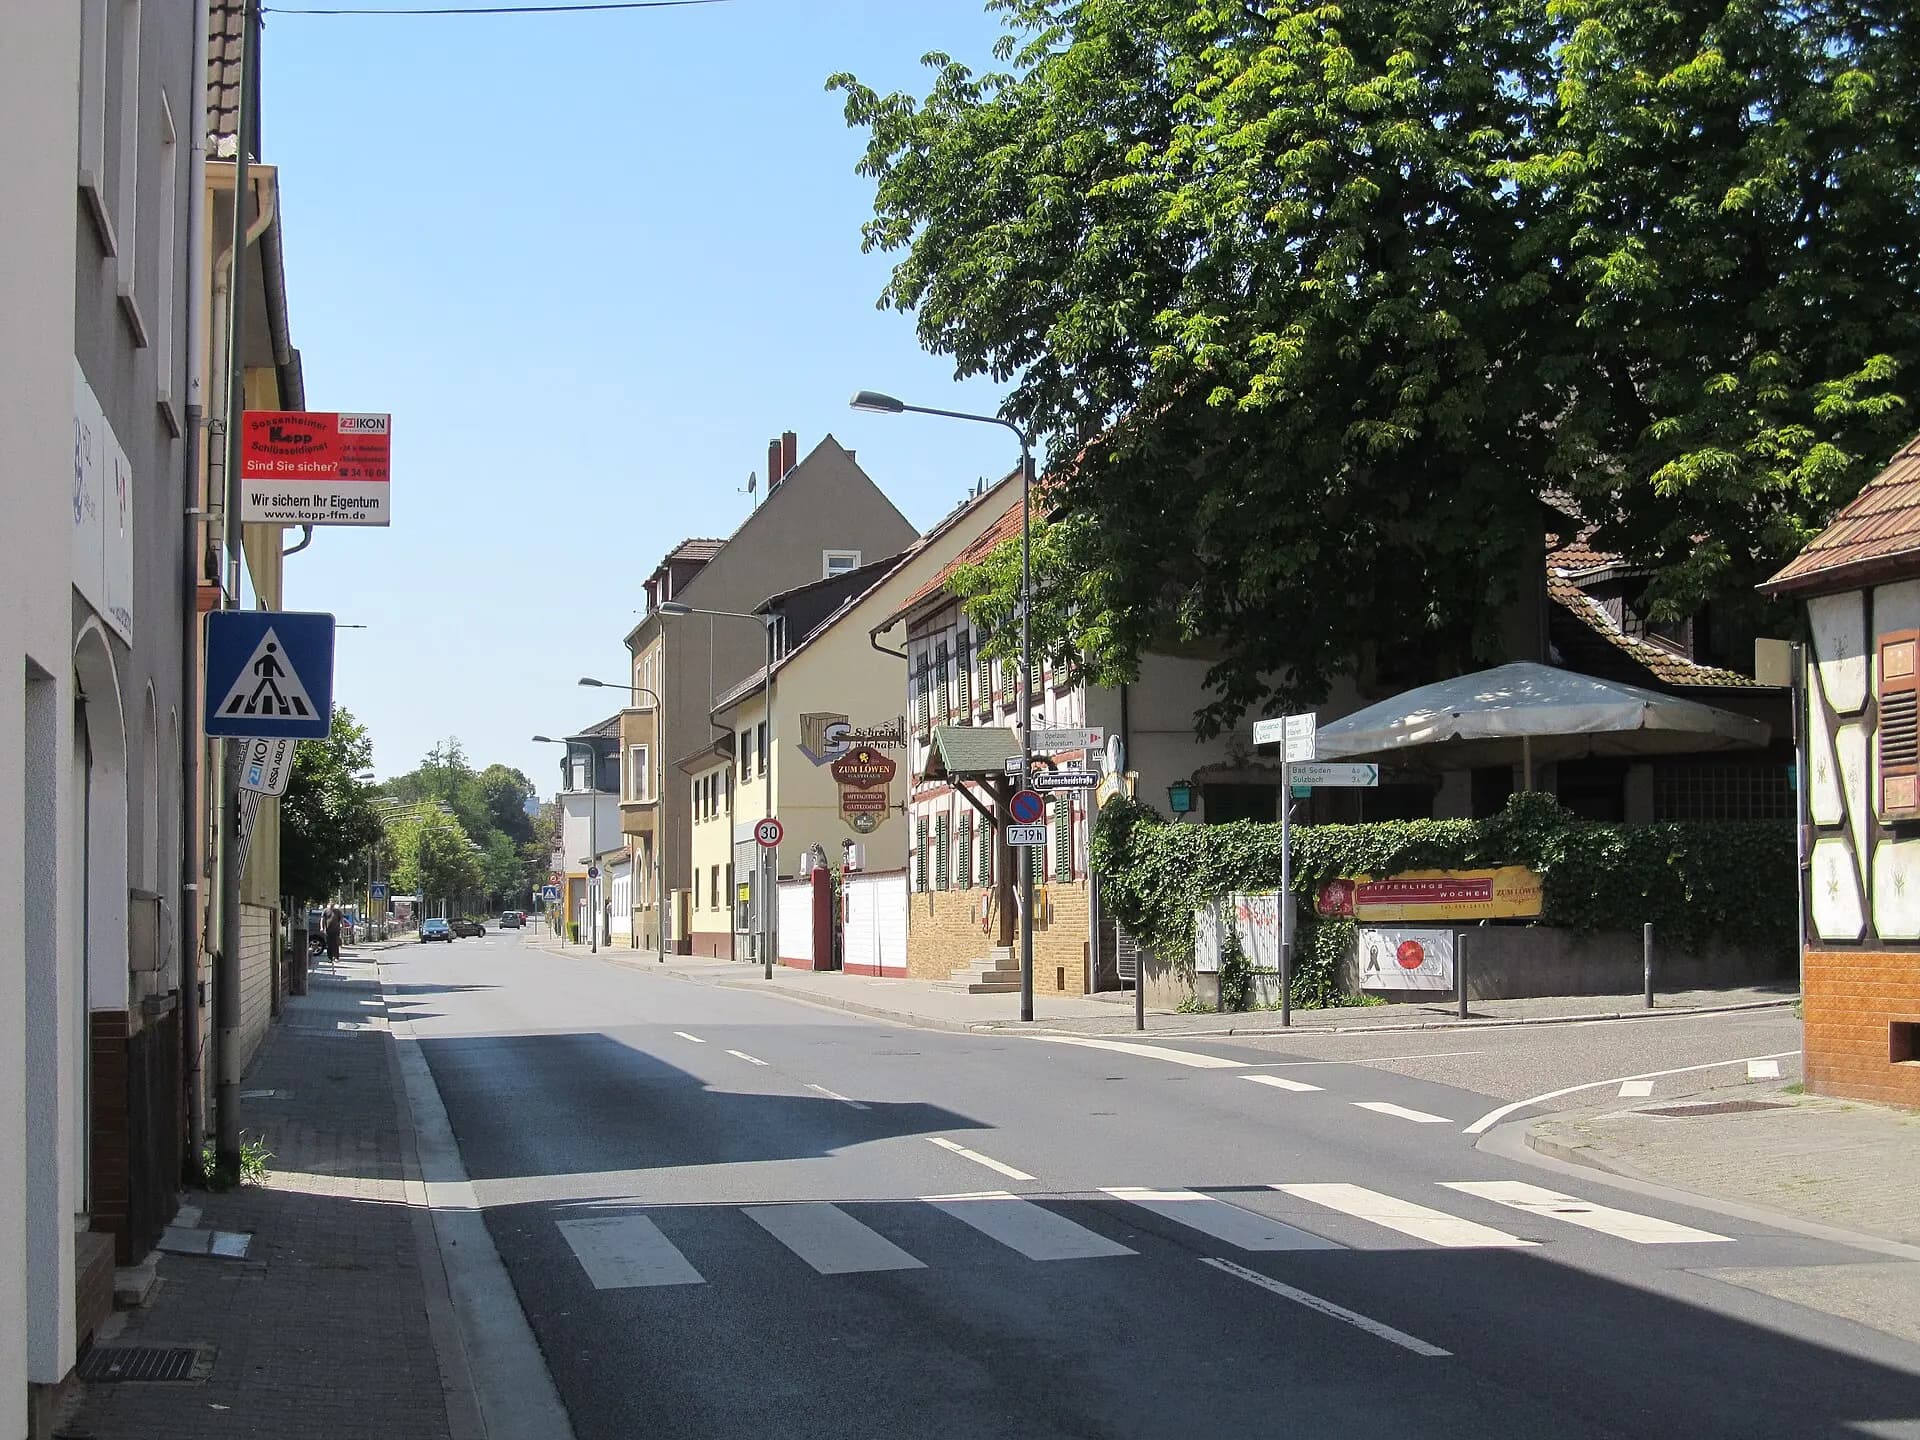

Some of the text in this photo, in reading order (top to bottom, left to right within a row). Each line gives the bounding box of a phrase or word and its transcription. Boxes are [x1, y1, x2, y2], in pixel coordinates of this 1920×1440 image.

[247, 460, 338, 473] Sind Sie sicher?
[251, 493, 380, 510] Wir sichern Ihr Eigentum
[264, 510, 366, 521] www.kopp-ffm.de
[838, 765, 857, 773] ZUM
[267, 767, 280, 790] ASSA
[760, 826, 778, 840] 30
[1011, 829, 1043, 841] 7-19 h
[1440, 890, 1489, 898] WOCHEN
